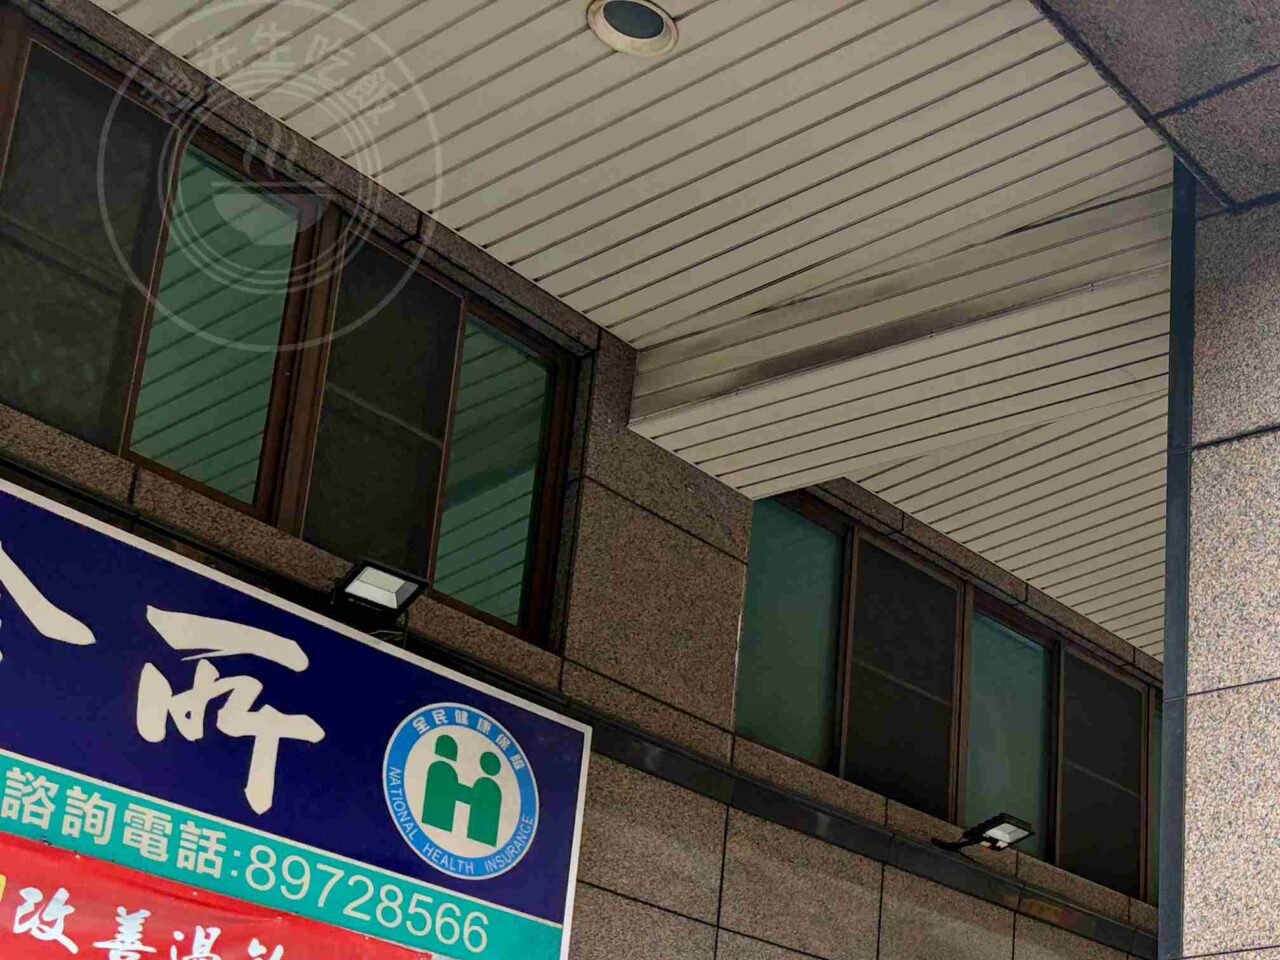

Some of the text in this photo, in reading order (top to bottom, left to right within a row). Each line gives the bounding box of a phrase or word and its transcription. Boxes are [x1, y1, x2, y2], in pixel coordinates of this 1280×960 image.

[412, 708, 526, 772] 全民健康保險
[389, 766, 534, 874] NATIONAL HEALTH INSURANCE
